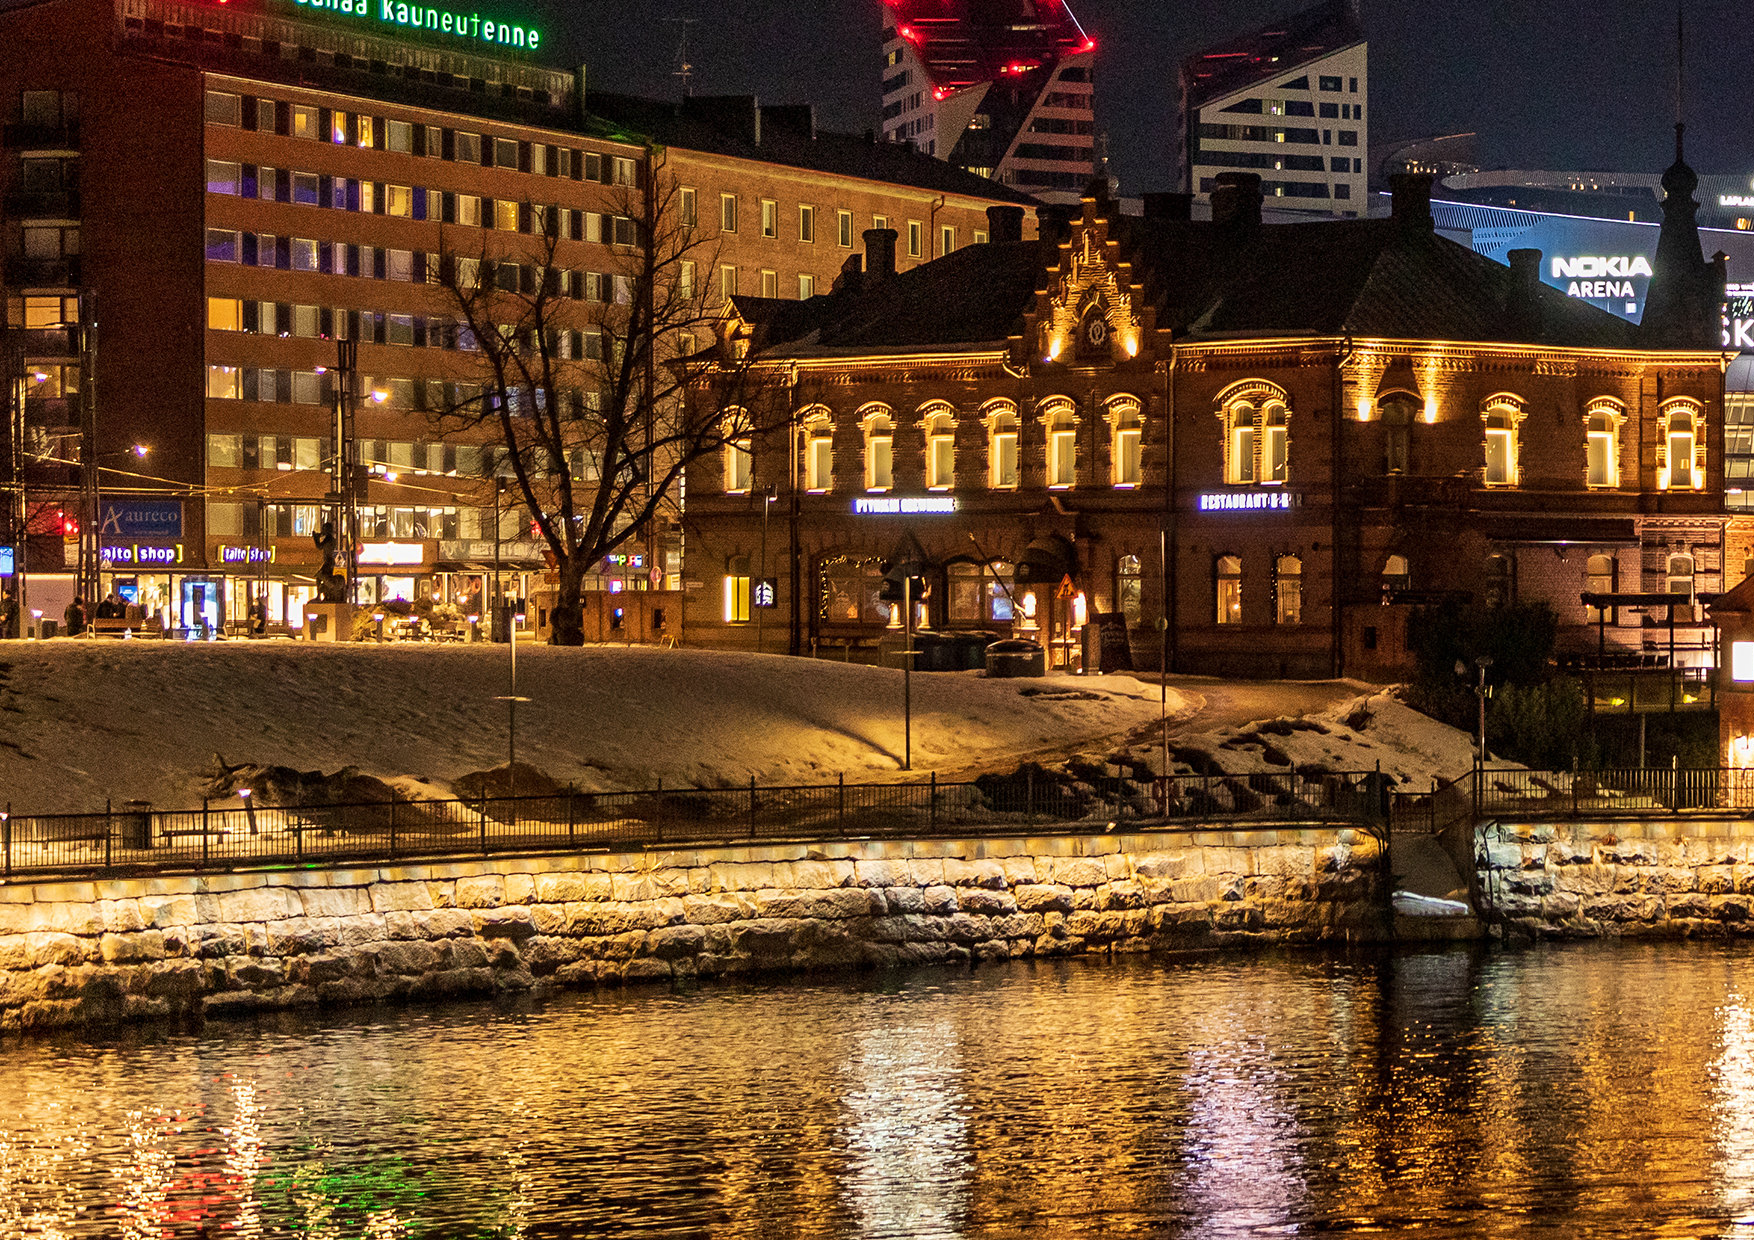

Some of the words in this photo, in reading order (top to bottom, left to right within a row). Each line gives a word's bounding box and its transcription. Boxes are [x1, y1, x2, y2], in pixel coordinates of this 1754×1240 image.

[1552, 256, 1653, 278] NOKIA
[1567, 281, 1635, 298] ARENA
[1200, 493, 1269, 510] RESTAURANT
[124, 511, 178, 523] aureco
